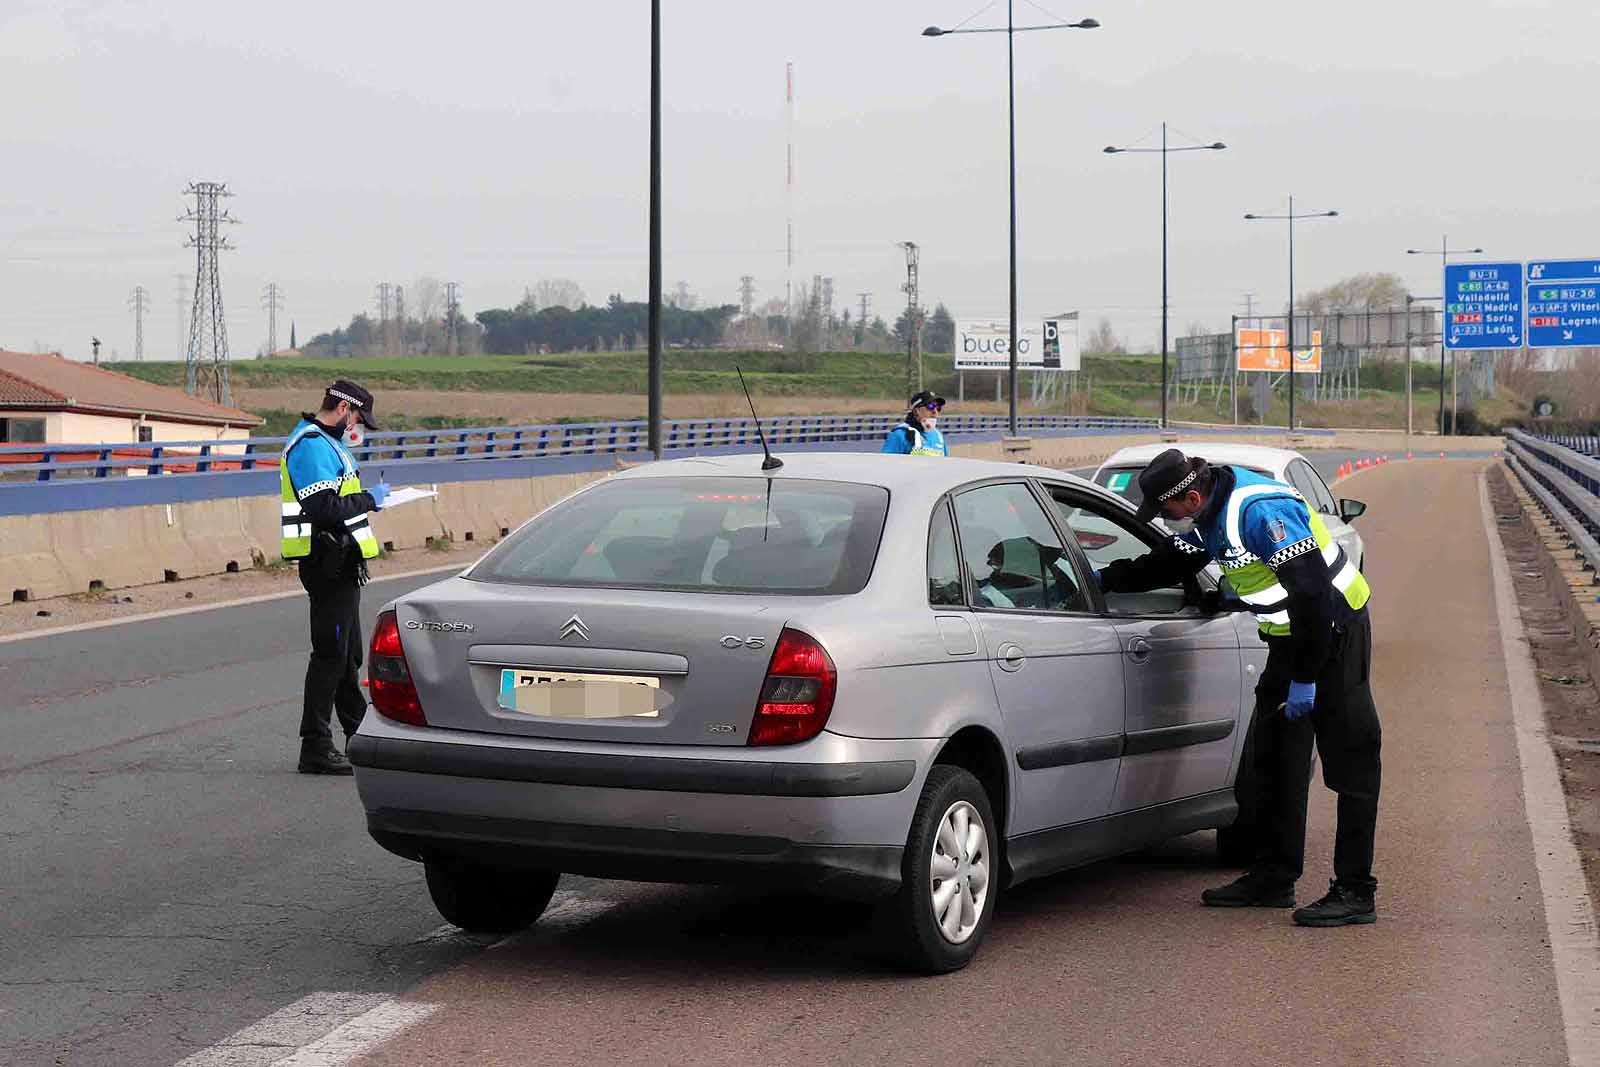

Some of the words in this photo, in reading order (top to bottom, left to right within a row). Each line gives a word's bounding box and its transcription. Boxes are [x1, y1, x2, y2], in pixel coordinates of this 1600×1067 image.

[1458, 292, 1510, 302] Valladolid
[1484, 303, 1519, 312] Madrid
[1486, 314, 1515, 322] Soria
[1561, 317, 1600, 328] Logroñ
[1486, 324, 1514, 334] León
[962, 332, 1031, 354] bueo
[719, 634, 766, 651] C5
